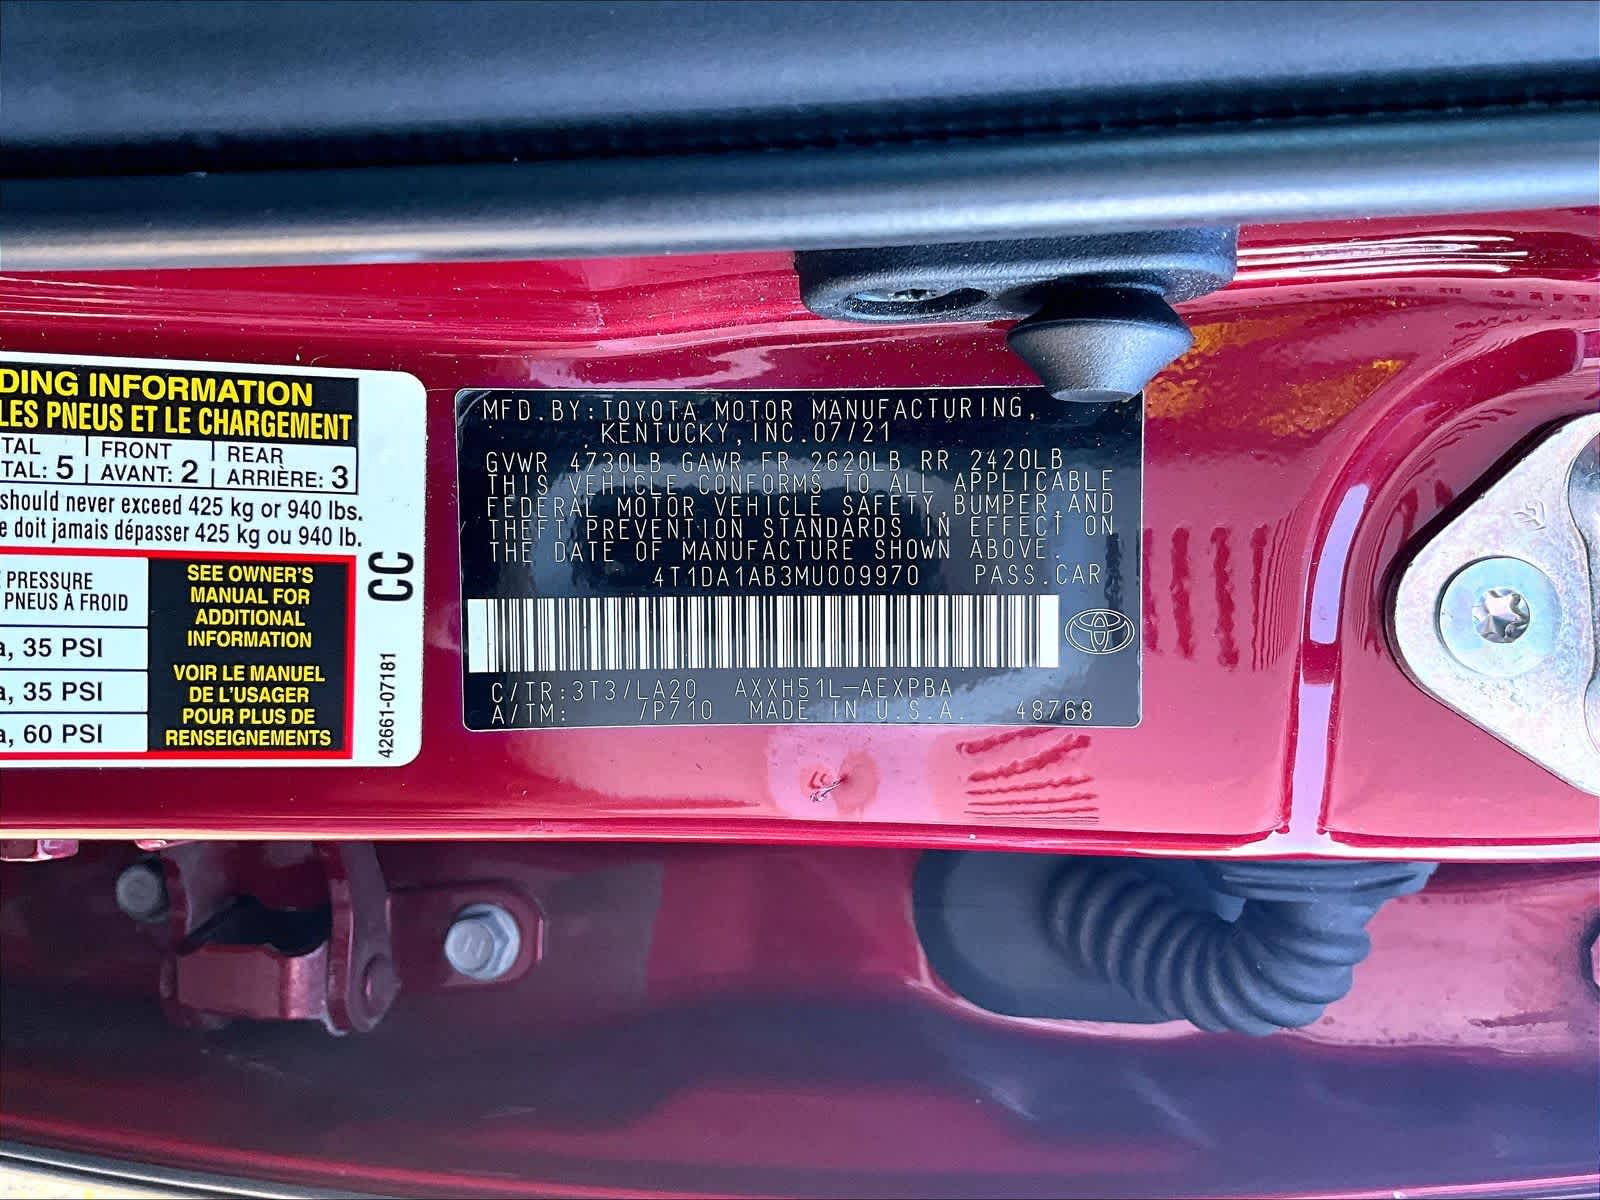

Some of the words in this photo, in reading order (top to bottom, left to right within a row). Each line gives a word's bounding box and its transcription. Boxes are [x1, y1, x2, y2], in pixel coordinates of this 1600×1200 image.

[0, 369, 79, 396] DING
[89, 373, 314, 407] INFORMATION
[715, 400, 793, 420] MOTOR
[811, 397, 1036, 420] MANUFACTURING,
[0, 399, 39, 428] LES
[47, 401, 124, 432] PNEUS
[132, 405, 156, 433] ET
[165, 406, 192, 434] LE
[199, 407, 353, 441] CHARGEMENT
[1, 437, 41, 455] TAL
[101, 441, 172, 460] FRONT
[228, 446, 284, 464] REAR
[56, 455, 74, 480] 5
[100, 464, 173, 483] AVANT:
[181, 459, 199, 484] 2
[486, 452, 548, 473] GVWR
[570, 452, 661, 473] 4730LB
[682, 452, 741, 472] GAWR
[762, 451, 789, 472] FR
[811, 451, 900, 472] 2620LB
[921, 450, 949, 471] RR
[970, 448, 1063, 470] 2420LB
[227, 465, 324, 488] ARRIÈRE:
[331, 465, 349, 490] 3
[487, 475, 548, 496] THIS
[569, 474, 677, 495] VEHICLE
[699, 474, 821, 495] CONFORMS
[843, 474, 869, 493] TO
[889, 473, 933, 494] ALL
[953, 470, 1113, 493] APPLICABLE
[0, 489, 58, 511] should
[66, 496, 115, 513] never
[121, 495, 182, 516] exceed
[188, 497, 224, 516] 425
[231, 496, 254, 522] kg
[261, 503, 282, 519] or
[287, 500, 322, 520] 940
[328, 500, 363, 521] lbs.
[488, 497, 598, 518] FEDERAL
[617, 497, 694, 517] MOTOR
[715, 496, 821, 517] VEHICLE
[15, 516, 46, 538] doit
[52, 517, 108, 543] jamais
[114, 519, 190, 548] dépasser
[195, 523, 230, 542] 425
[237, 523, 260, 549] kg
[267, 527, 292, 545] ou
[298, 526, 333, 546] 940
[339, 527, 363, 547] lb.
[489, 520, 564, 541] THEFT
[586, 519, 743, 540] PREVENTION
[763, 517, 901, 539] STANDARDS
[925, 517, 950, 537] IN
[970, 513, 1062, 537] EFFECT
[1084, 515, 1113, 536] ON
[489, 541, 532, 563] THE
[554, 541, 614, 562] DATE
[636, 541, 661, 561] OF
[682, 539, 853, 561] MANUFACTURE
[874, 539, 950, 560] SHOWN
[969, 538, 1060, 559] ABOVE.
[7, 571, 93, 591] PRESSURE
[187, 565, 224, 583] SEE
[229, 566, 314, 583] OWNER'S
[368, 551, 414, 602] CC
[654, 564, 919, 587] 4T1DA1AB3MU009970
[4, 592, 58, 611] PNEUS
[64, 586, 74, 611] À
[80, 593, 128, 612] FROID
[191, 587, 269, 604] MANUAL
[273, 589, 311, 605] FOR
[195, 609, 306, 626] ADDITIONAL
[23, 637, 52, 657] 35
[62, 637, 103, 657] PSI
[187, 631, 312, 648] INFORMATION
[174, 664, 218, 682] VOIR
[223, 665, 247, 682] LE
[250, 665, 326, 682] MANUEL
[23, 681, 52, 701] 35
[62, 681, 103, 701] PSI
[190, 686, 214, 703] DE
[218, 686, 309, 703] L'USAGER
[735, 677, 953, 698] AXXH51L-AEXPBA
[183, 708, 236, 725] POUR
[239, 708, 287, 725] PLUS
[291, 708, 316, 725] DE
[378, 653, 396, 758] 42661-07181
[491, 703, 566, 725] A/TM:
[639, 700, 713, 721] /P710
[750, 699, 809, 720] MADE
[833, 700, 857, 719] IN
[1016, 700, 1093, 721] 48768
[23, 724, 52, 743] 60
[62, 724, 103, 743] PSI
[165, 730, 332, 747] RENSEIGNEMENTS
